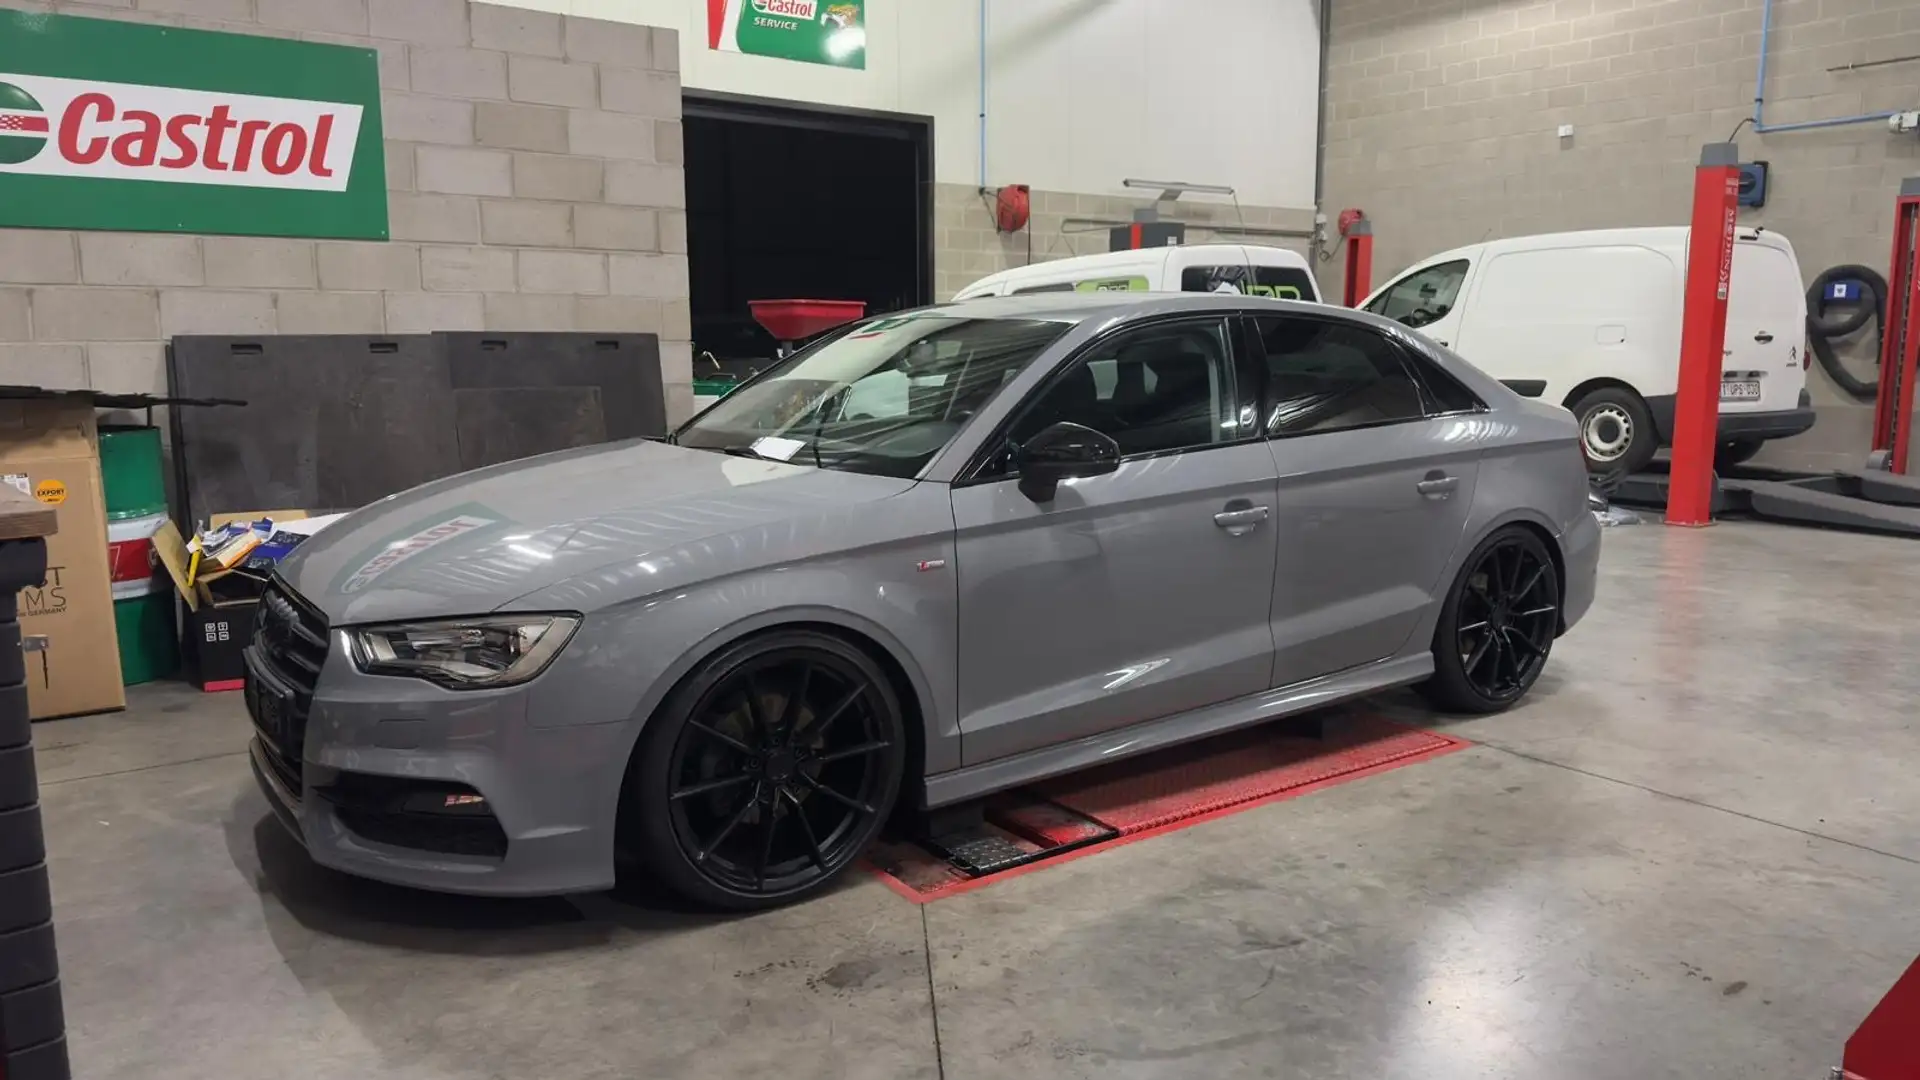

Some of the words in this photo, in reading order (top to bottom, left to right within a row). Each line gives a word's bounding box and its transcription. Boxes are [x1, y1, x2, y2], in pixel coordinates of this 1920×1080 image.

[767, 0, 812, 17] Castrol
[754, 17, 798, 31] SERVICE
[57, 92, 335, 178] Castrol
[36, 488, 65, 497] EXPORT
